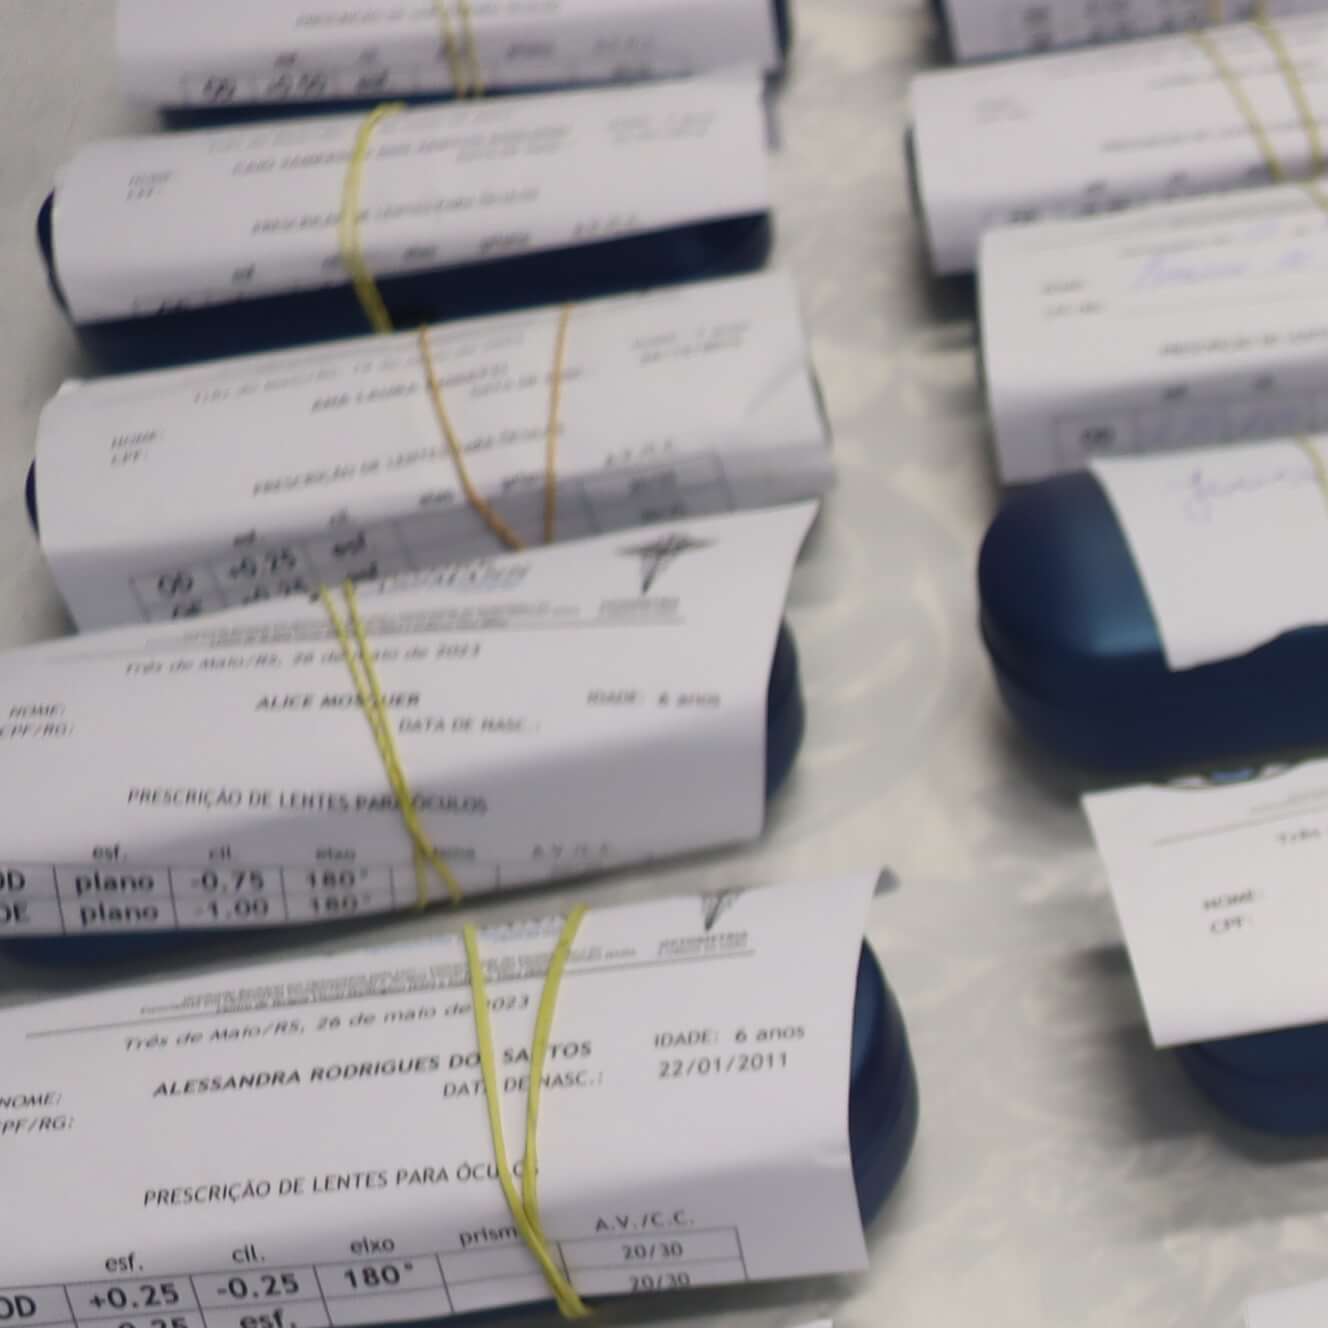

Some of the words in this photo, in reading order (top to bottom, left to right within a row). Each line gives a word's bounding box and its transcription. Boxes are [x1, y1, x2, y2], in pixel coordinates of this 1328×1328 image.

[255, 695, 313, 711] ALICE
[399, 718, 445, 733] DATA
[452, 718, 472, 732] DE
[249, 791, 271, 808] DE
[279, 792, 348, 811] LENTES
[75, 871, 155, 897] plano
[80, 904, 159, 926] plano
[124, 1035, 168, 1052] Três
[176, 1028, 203, 1045] de
[316, 1015, 340, 1031] 26
[348, 1011, 376, 1026] de
[384, 1006, 437, 1024] maio
[444, 1001, 473, 1018] de
[654, 1028, 720, 1049] IDADE:
[734, 1028, 748, 1043] 6
[755, 1024, 806, 1042] anos
[153, 1069, 300, 1098] ALESSANDRA
[310, 1054, 440, 1083] RODRIGUES
[503, 1041, 592, 1063] SATOS
[659, 1052, 788, 1079] 22/01/2011
[503, 1074, 529, 1092] DE
[0, 1116, 75, 1135] PF/RG:
[144, 1179, 271, 1207] PRESCRIÇÃO
[279, 1177, 305, 1195] DE
[312, 1169, 388, 1193] LENTES
[397, 1165, 449, 1185] PARA
[105, 1253, 144, 1274] esf.
[232, 1244, 266, 1265] cil.
[349, 1237, 395, 1256] eixo
[459, 1227, 521, 1249] prism
[89, 1283, 180, 1312] +0.25
[216, 1272, 300, 1300] -0.25
[343, 1263, 412, 1290] 180°
[622, 1242, 684, 1261] 20/30
[629, 1272, 691, 1292] 20/30
